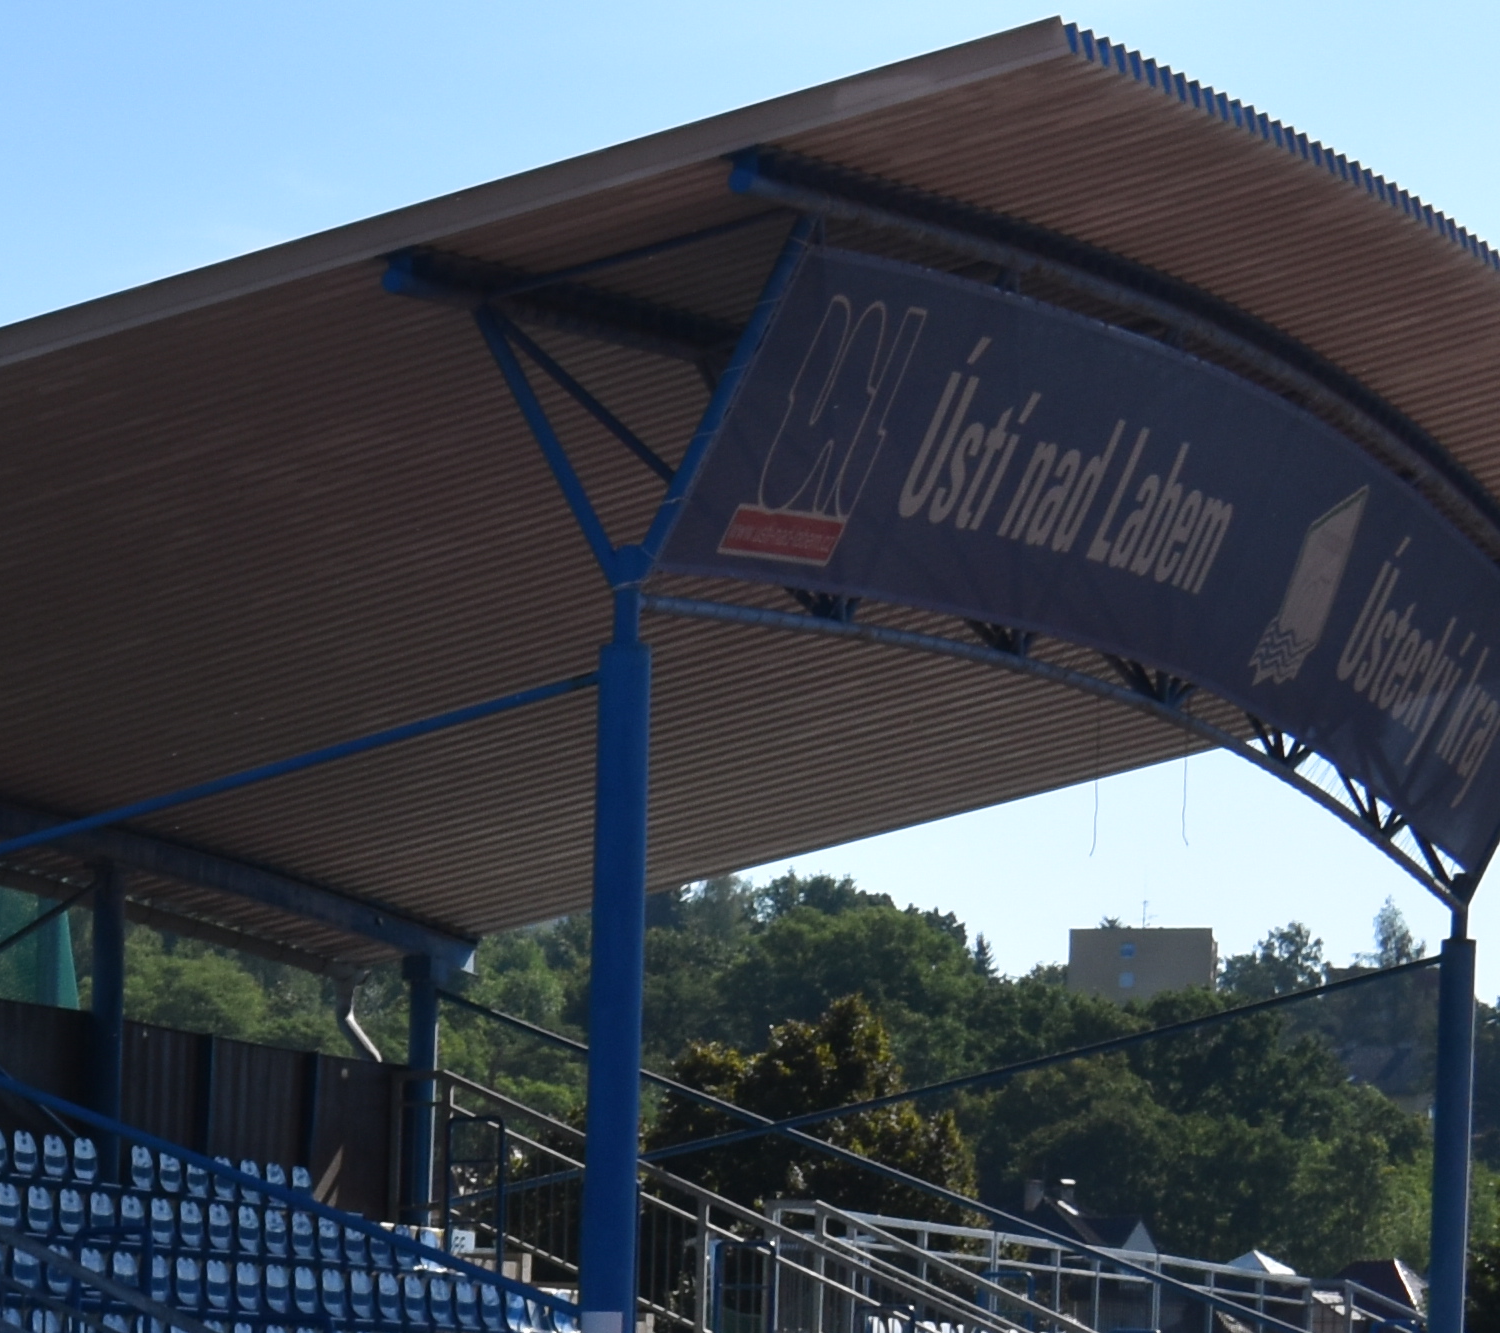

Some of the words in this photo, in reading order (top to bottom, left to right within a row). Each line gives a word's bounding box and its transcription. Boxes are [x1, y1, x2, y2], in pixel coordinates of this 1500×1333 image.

[899, 337, 1041, 531] Ústí
[997, 418, 1126, 553] nad
[1086, 427, 1234, 595] Labem
[1337, 535, 1476, 767] Ústecký
